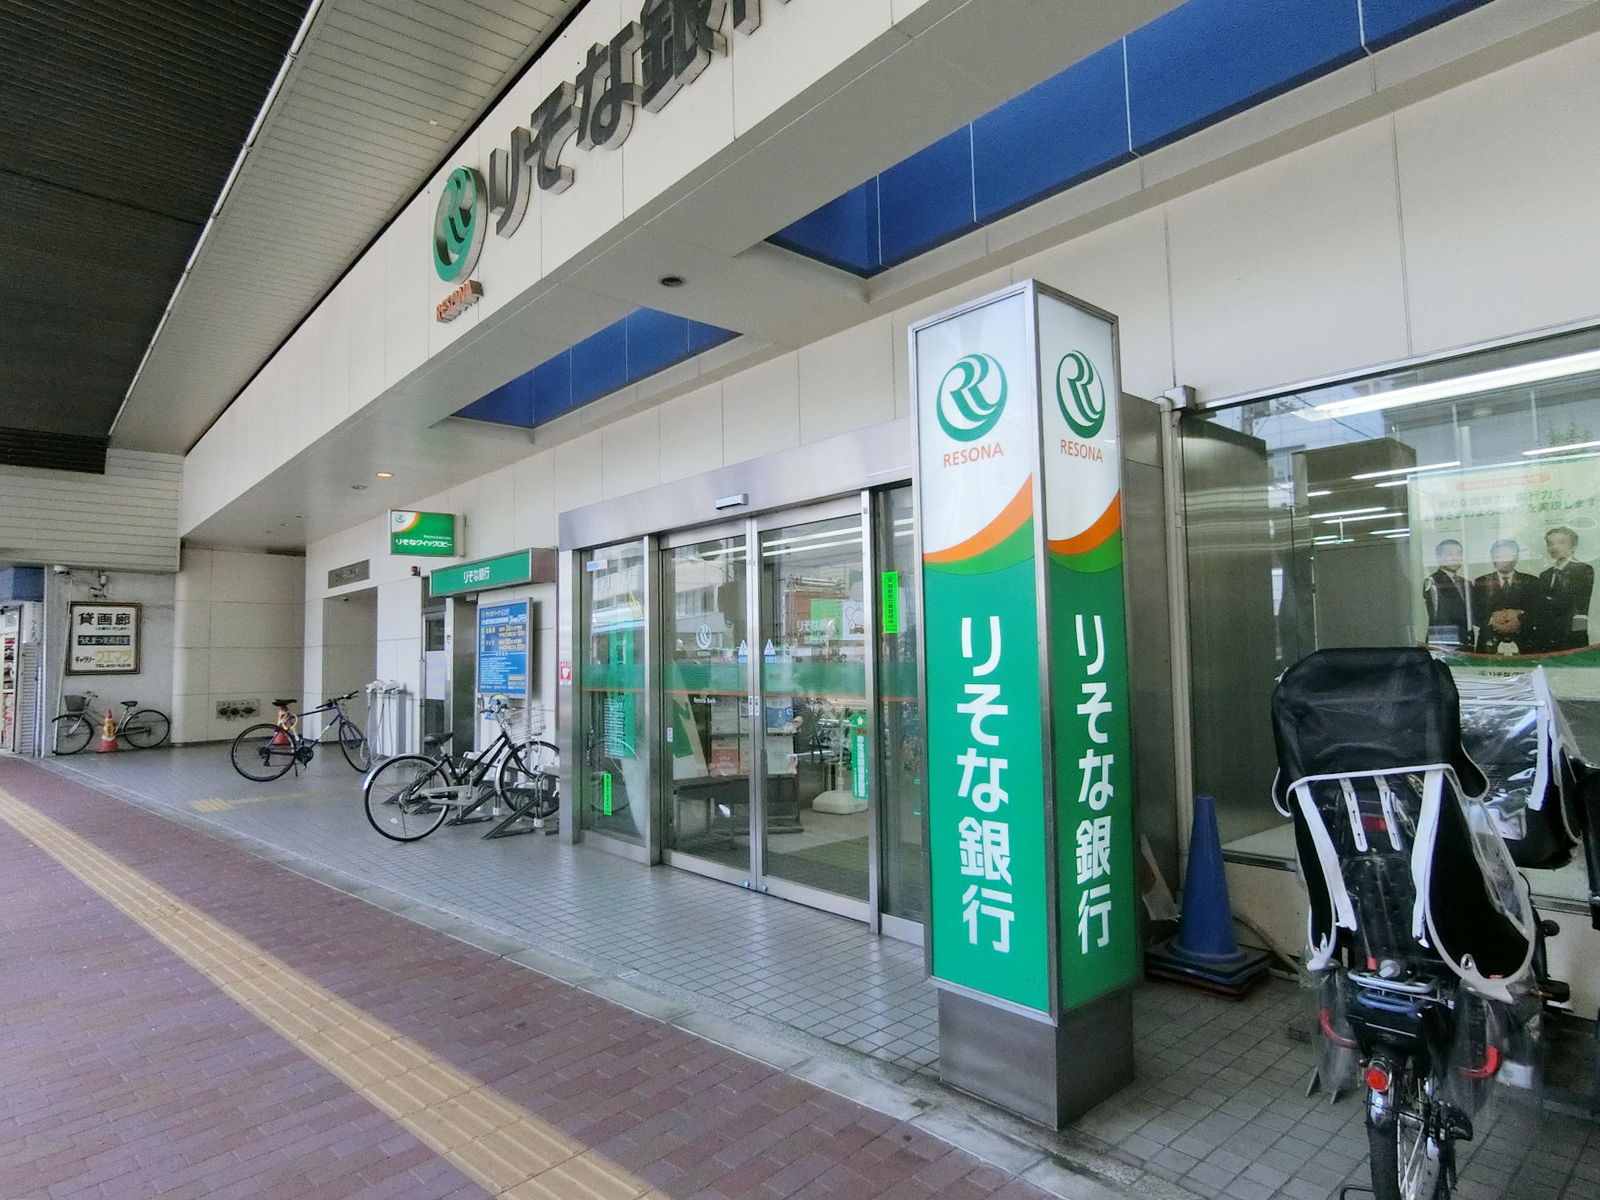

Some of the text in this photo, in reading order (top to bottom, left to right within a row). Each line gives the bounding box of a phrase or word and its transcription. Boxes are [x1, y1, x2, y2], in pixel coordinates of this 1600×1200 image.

[489, 0, 791, 239] りそな銀
[436, 280, 483, 323] RESONA
[943, 442, 1005, 468] RESONA
[1060, 439, 1104, 463] RESONA
[395, 538, 453, 548] りそなクイックロビー
[463, 566, 490, 584] りそな銀行
[78, 612, 131, 626] 貸画廊
[957, 615, 1015, 954] りそな銀行
[1075, 614, 1115, 955] りそな銀行
